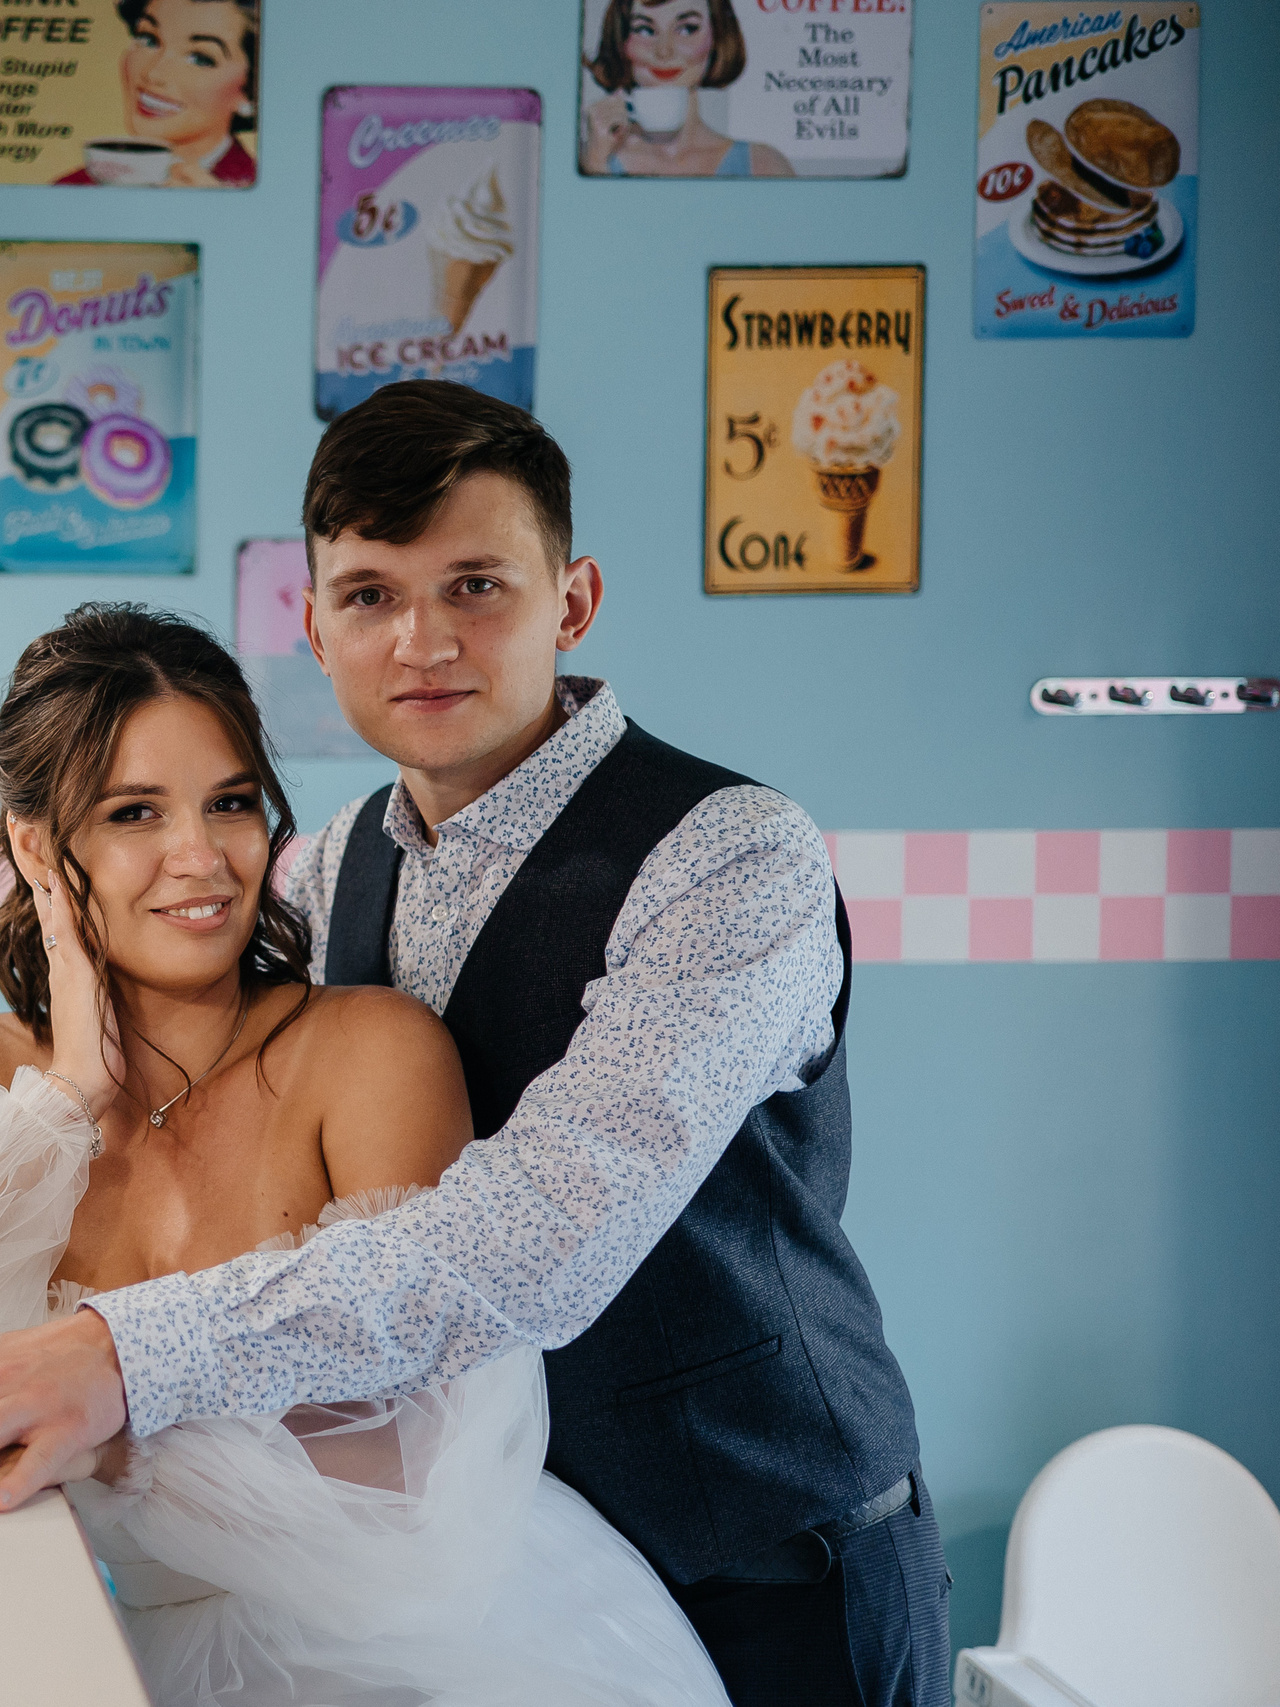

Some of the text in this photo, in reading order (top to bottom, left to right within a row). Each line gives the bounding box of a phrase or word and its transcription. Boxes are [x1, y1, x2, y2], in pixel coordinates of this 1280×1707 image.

[805, 22, 854, 44] The
[994, 10, 1124, 59] American
[0, 56, 78, 80] Stupid
[798, 48, 860, 69] Most
[993, 14, 1186, 114] Pancakes
[764, 71, 893, 97] Necessary
[793, 95, 860, 116] of All
[13, 120, 73, 139] More
[795, 119, 859, 141] Evils
[5, 272, 175, 346] Donuts
[1059, 294, 1080, 321] &
[1083, 292, 1179, 329] Delicious
[336, 331, 509, 371] ICE CREAM
